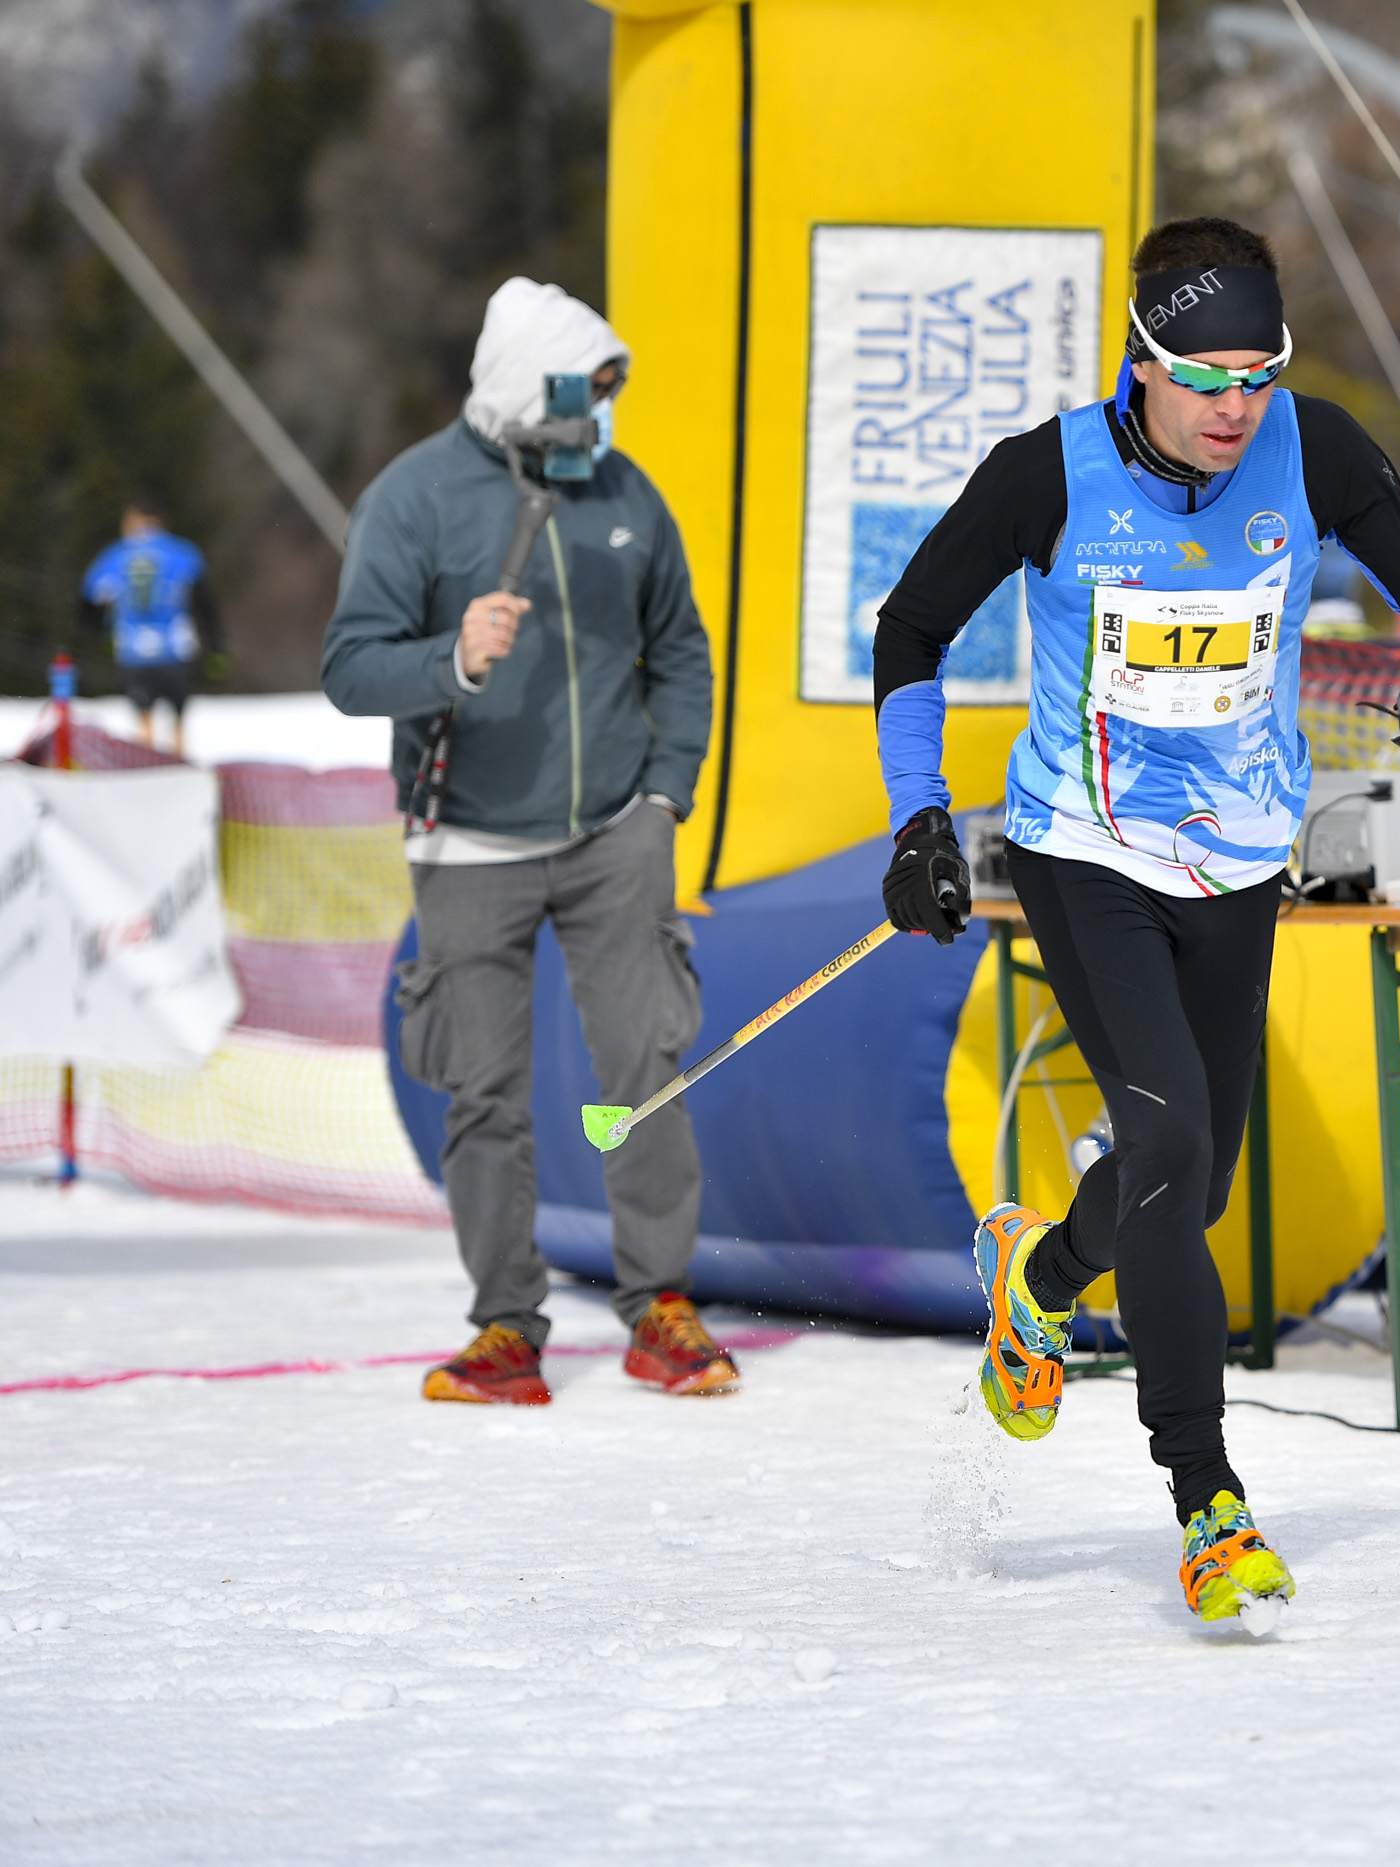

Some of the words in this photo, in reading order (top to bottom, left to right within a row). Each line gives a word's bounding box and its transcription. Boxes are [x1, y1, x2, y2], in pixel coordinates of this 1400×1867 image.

[852, 290, 912, 486] FRIULI
[915, 278, 975, 491] VENEZIA
[1076, 564, 1143, 579] FISKY
[1163, 626, 1218, 663] 17
[1195, 665, 1221, 673] DANIELE
[821, 937, 872, 978] carbon
